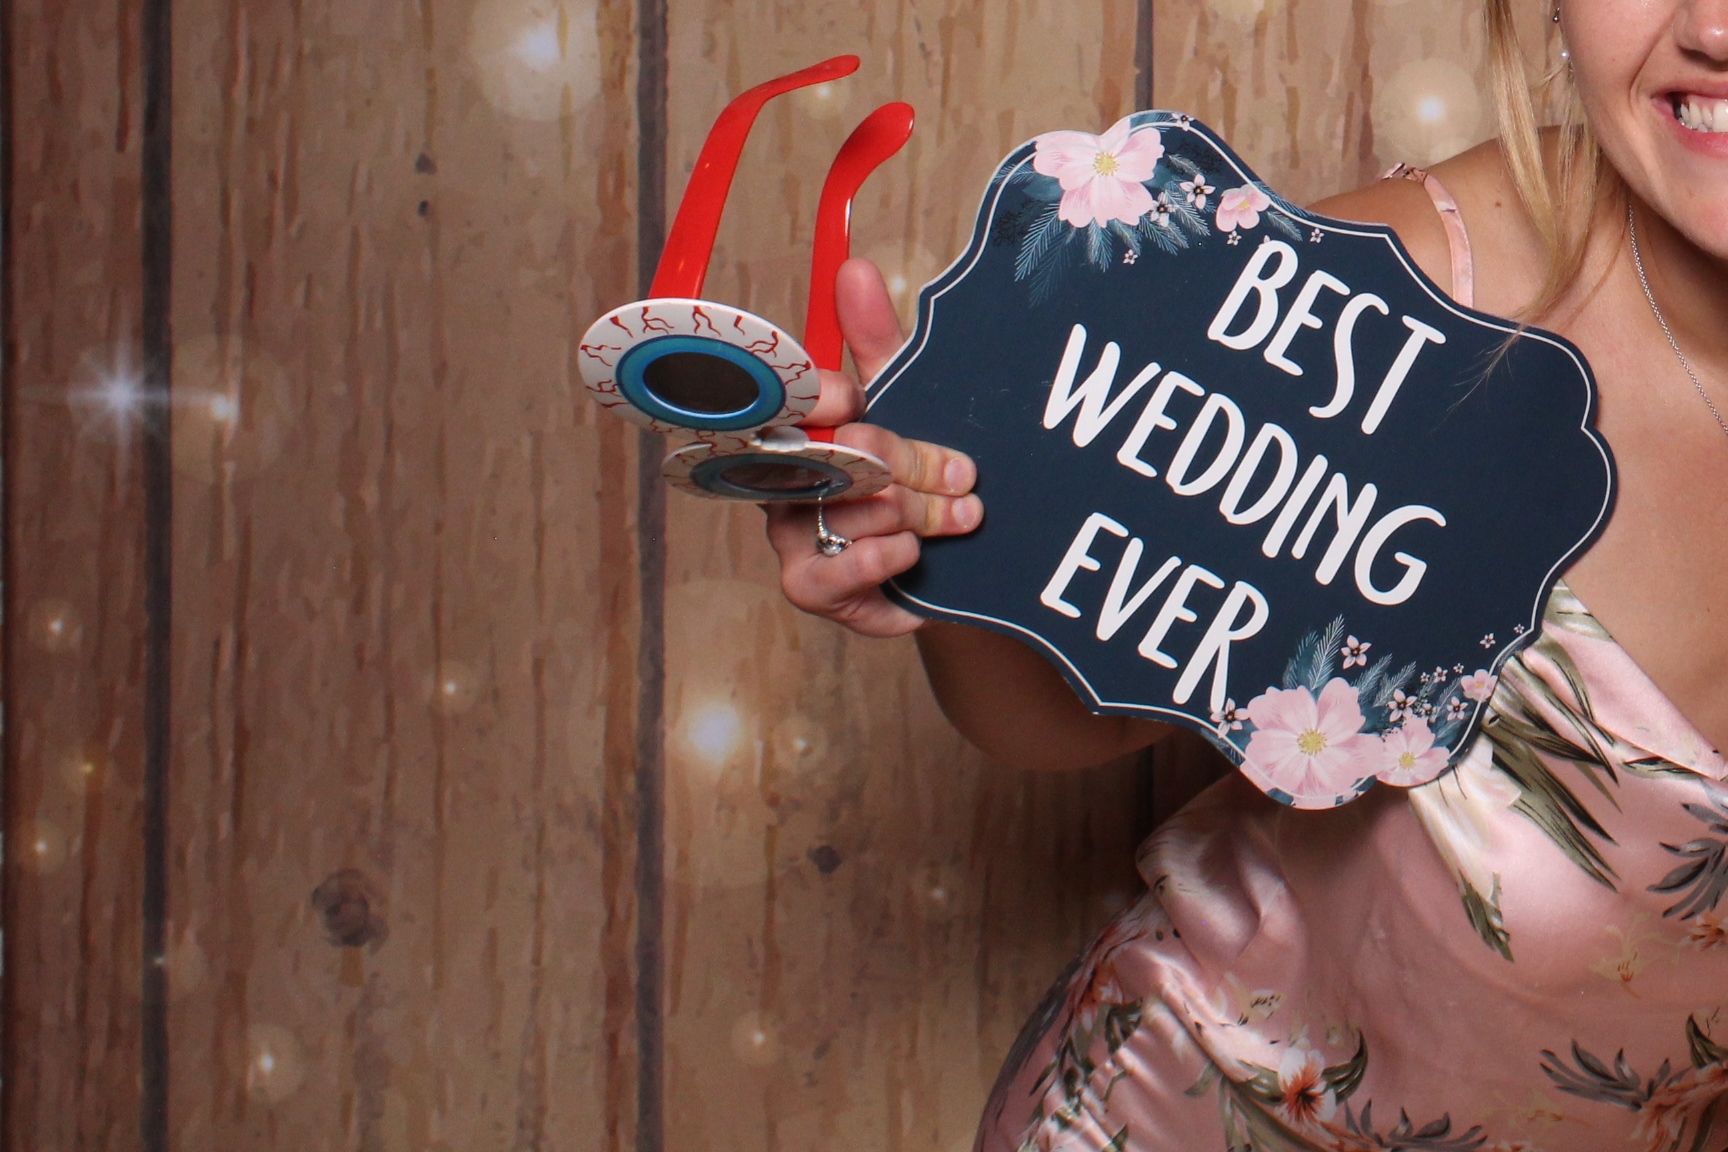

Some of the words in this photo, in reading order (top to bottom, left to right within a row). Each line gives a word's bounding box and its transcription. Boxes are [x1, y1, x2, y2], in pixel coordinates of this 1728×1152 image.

[1207, 239, 1447, 435] BEST
[1042, 322, 1447, 606] WEDDING
[1039, 511, 1270, 713] EVER
